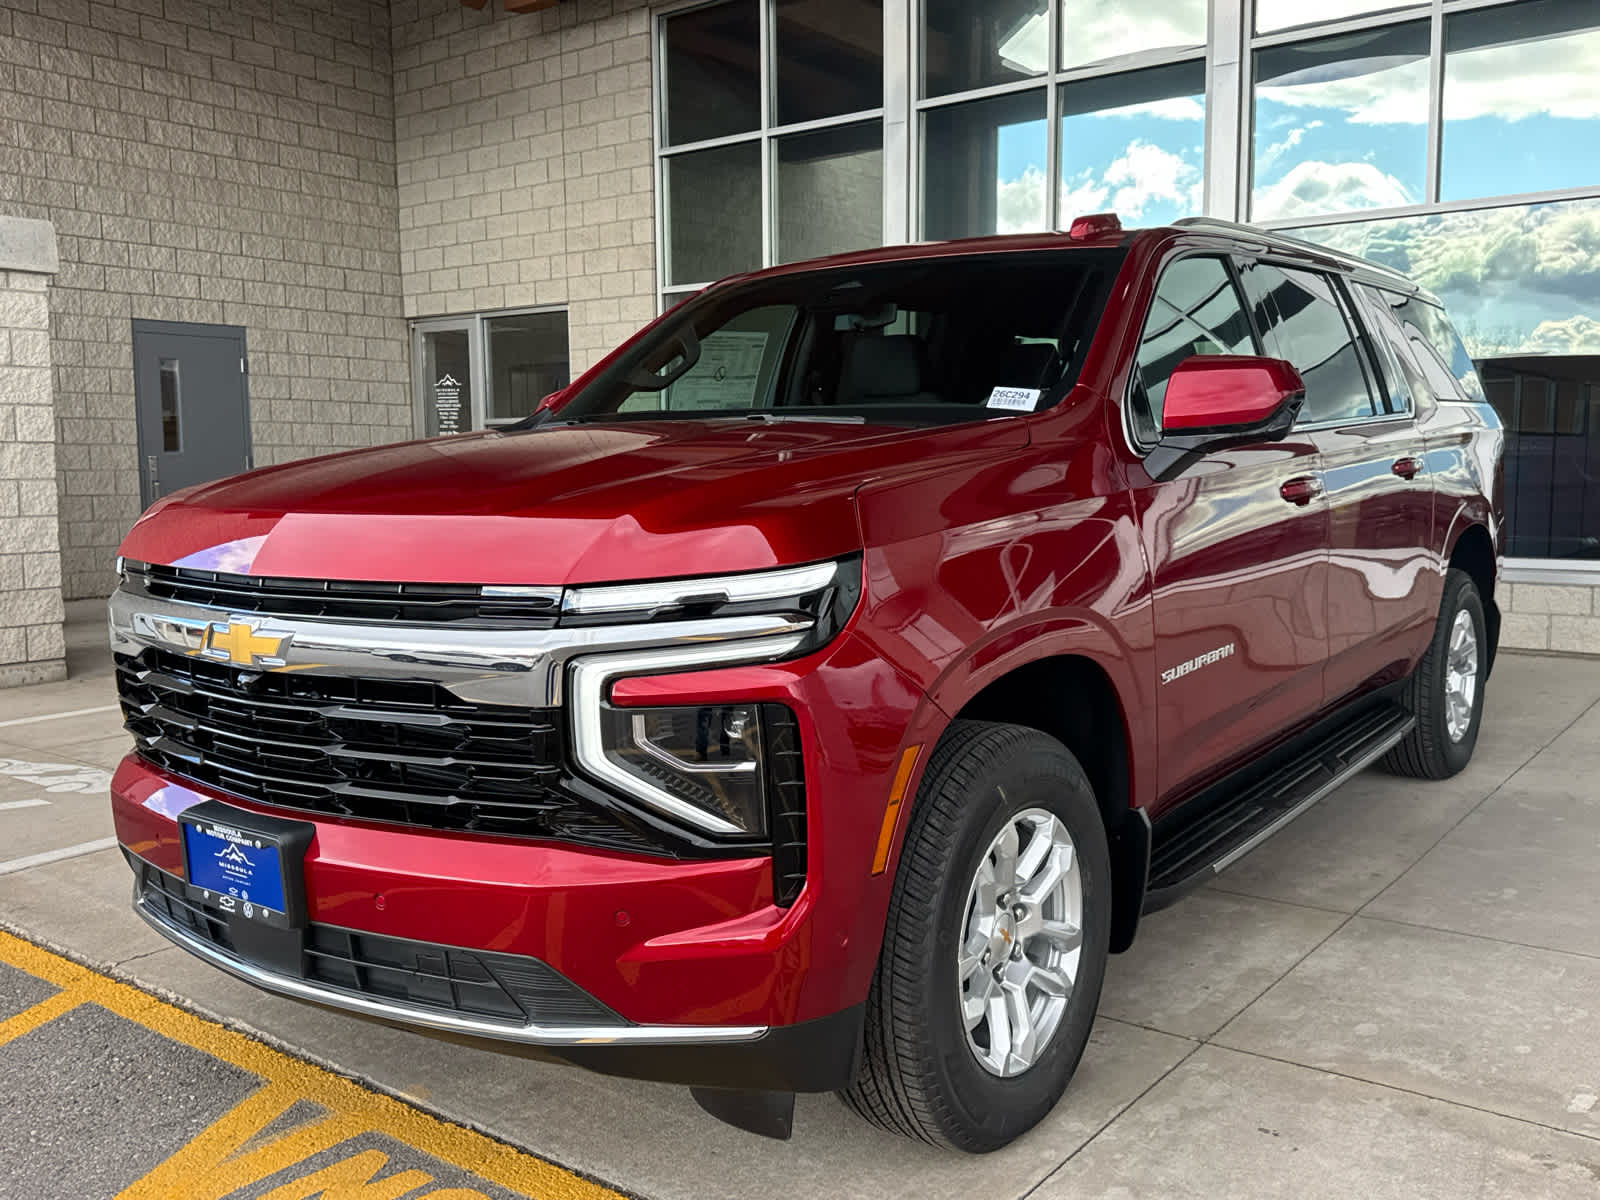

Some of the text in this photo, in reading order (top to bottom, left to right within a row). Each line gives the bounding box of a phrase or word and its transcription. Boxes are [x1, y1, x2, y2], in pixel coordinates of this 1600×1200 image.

[992, 390, 1031, 400] 26C294
[1160, 642, 1235, 685] SUBURBAN
[218, 861, 253, 876] MISSOULA
